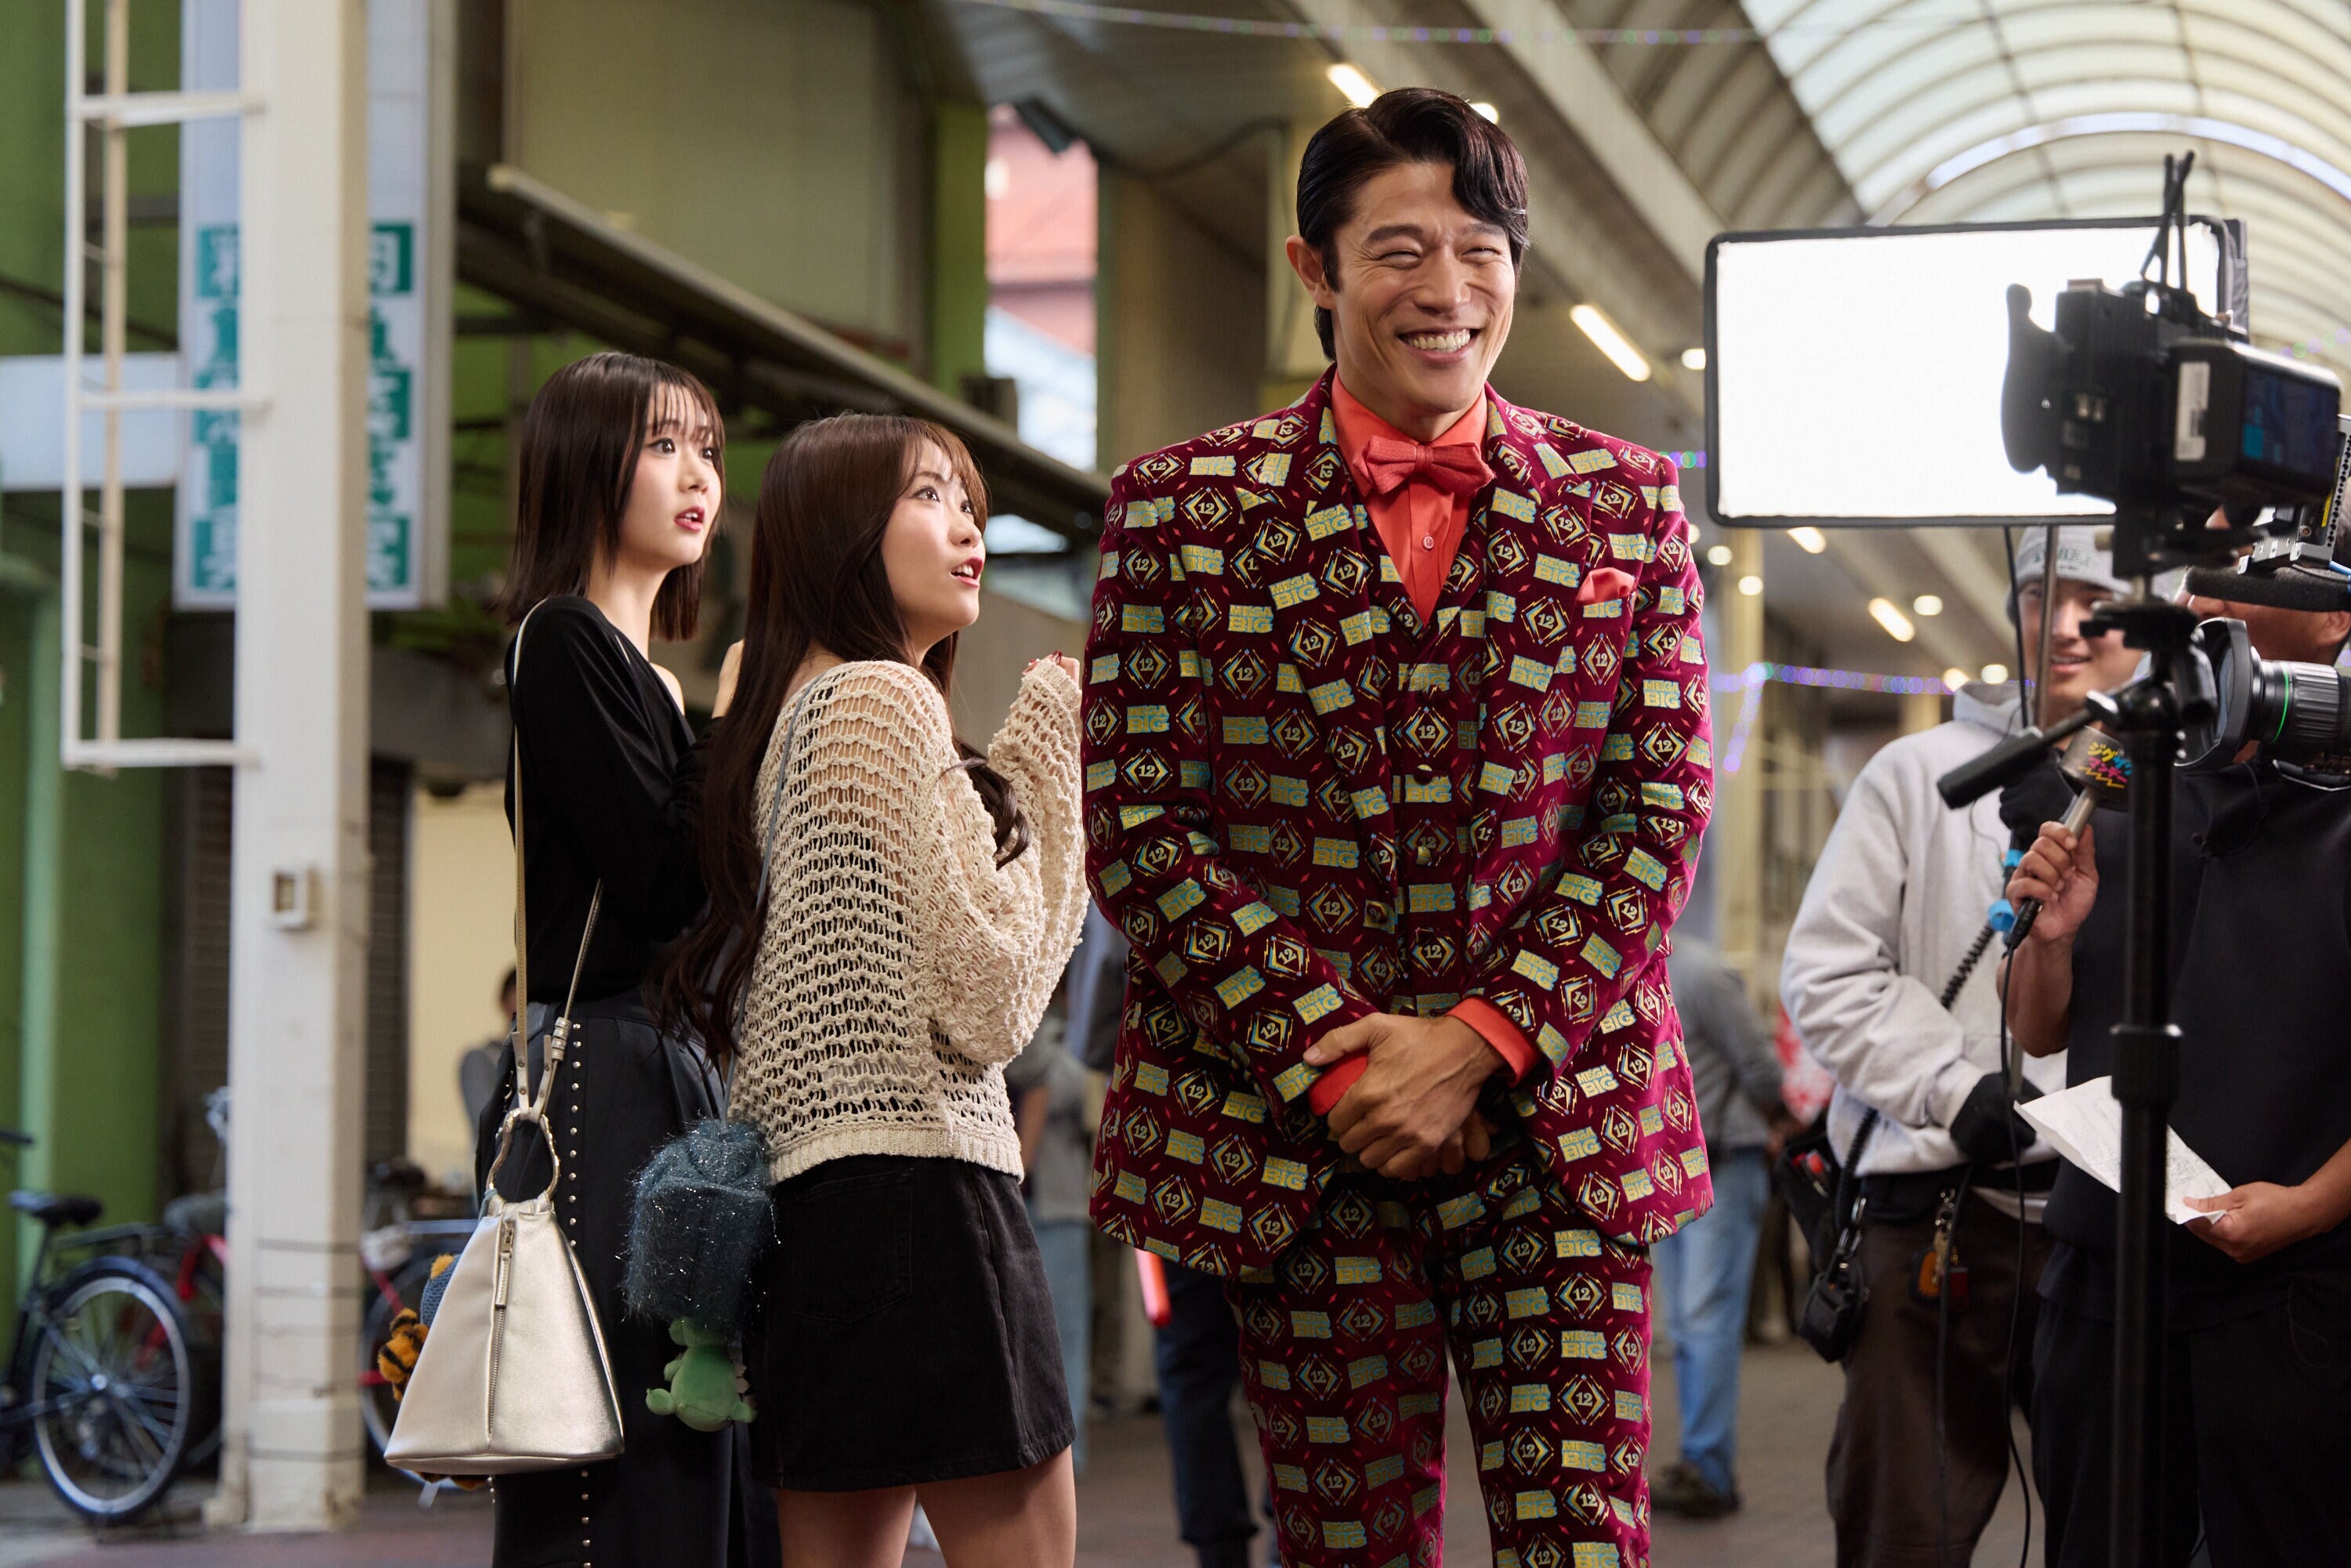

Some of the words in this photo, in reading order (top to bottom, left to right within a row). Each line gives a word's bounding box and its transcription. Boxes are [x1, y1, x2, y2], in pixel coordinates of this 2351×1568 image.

[1569, 449, 1612, 462] MEGA
[1571, 454, 1617, 473] BIG
[1633, 454, 1649, 463] 12
[1190, 463, 1234, 476] BIG
[1259, 454, 1283, 483] BIG
[1274, 454, 1291, 485] MEGA
[1494, 489, 1535, 509] MEGA
[1605, 494, 1621, 505] 12
[1199, 502, 1215, 514] 12
[1306, 505, 1346, 527] MEGA
[1492, 497, 1534, 522] BIG
[1308, 513, 1353, 540] BIG
[1559, 516, 1573, 531] 12
[1267, 532, 1284, 548] 12
[1610, 534, 1645, 543] MEGA
[1183, 546, 1223, 559] MEGA
[1497, 545, 1513, 559] 12
[1612, 543, 1646, 559] BIG
[1667, 541, 1679, 555] 12
[1136, 558, 1149, 570] 12
[1183, 556, 1223, 574] BIG
[1538, 554, 1578, 573] MEGA
[1337, 564, 1354, 580] 12
[1535, 562, 1578, 586] BIG
[1270, 574, 1313, 596] MEGA
[1273, 581, 1319, 609] BIG
[1123, 606, 1162, 617] MEGA
[1230, 607, 1271, 617] MEGA
[1122, 614, 1164, 632] BIG
[1229, 615, 1272, 632] BIG
[1538, 614, 1554, 628] 12
[1303, 636, 1320, 650] 12
[1662, 638, 1676, 649] 12
[1513, 656, 1552, 676] MEGA
[1596, 654, 1607, 665] 12
[1237, 668, 1253, 681] 12
[1509, 665, 1550, 691] BIG
[1309, 679, 1348, 699] MEGA
[1644, 680, 1679, 693] MEGA
[1313, 687, 1354, 714] BIG
[1645, 690, 1679, 708] BIG
[1128, 706, 1168, 717] MEGA
[1094, 716, 1106, 728] 12
[1128, 715, 1168, 733] BIG
[1510, 720, 1525, 734] 12
[1419, 726, 1436, 738] 12
[1338, 744, 1356, 758] 12
[1657, 741, 1672, 752] 12
[1139, 765, 1156, 777] 12
[1699, 796, 1712, 809] 12
[1502, 817, 1536, 832] MEGA
[1661, 819, 1677, 832] 12
[1502, 826, 1537, 848] BIG
[1315, 838, 1357, 853] MEGA
[1592, 842, 1608, 853] 12
[1149, 848, 1167, 863] 12
[1314, 848, 1357, 867] BIG
[1631, 848, 1667, 877] MEGA
[1624, 855, 1665, 890] BIG
[1509, 878, 1523, 892] 12
[1562, 874, 1602, 892] MEGA
[1157, 878, 1197, 909] MEGA
[1556, 881, 1600, 905] BIG
[1161, 885, 1205, 922] BIG
[1621, 904, 1638, 919] 12
[1232, 901, 1267, 923] MEGA
[1237, 907, 1277, 936] BIG
[1550, 919, 1567, 932] 12
[1198, 934, 1218, 950] 12
[1588, 933, 1622, 966] MEGA
[1278, 948, 1297, 964] 12
[1425, 945, 1442, 958] 12
[1518, 951, 1559, 976] MEGA
[1581, 941, 1618, 979] BIG
[1216, 966, 1255, 996] MEGA
[1512, 958, 1556, 990] BIG
[1221, 972, 1265, 1009] BIG
[1294, 983, 1334, 1011] MEGA
[1299, 990, 1342, 1024] BIG
[1573, 991, 1588, 1009] 12
[1645, 996, 1654, 1009] 12
[1507, 1005, 1521, 1021] 12
[1261, 1023, 1278, 1039] 12
[1138, 1062, 1168, 1080] MEGA
[1630, 1059, 1646, 1073] 12
[1134, 1070, 1168, 1095] BIG
[1576, 1066, 1611, 1083] MEGA
[1188, 1085, 1204, 1098] 12
[1581, 1073, 1618, 1097] BIG
[1228, 1092, 1266, 1108] MEGA
[1223, 1099, 1265, 1122] BIG
[1672, 1103, 1682, 1116] 12
[1559, 1128, 1595, 1146] MEGA
[1614, 1123, 1628, 1137] 12
[1169, 1130, 1204, 1148] MEGA
[1165, 1139, 1203, 1163] BIG
[1562, 1135, 1601, 1162] BIG
[1680, 1147, 1704, 1164] MEGA
[1266, 1157, 1307, 1175] MEGA
[1661, 1166, 1672, 1179] 12
[1684, 1156, 1707, 1179] BIG
[1118, 1170, 1145, 1189] MEGA
[1262, 1166, 1306, 1190] BIG
[1621, 1168, 1649, 1186] MEGA
[1114, 1179, 1145, 1204] BIG
[1624, 1176, 1654, 1201] BIG
[1165, 1193, 1180, 1208] 12
[1591, 1192, 1607, 1204] 12
[1203, 1197, 1241, 1217] MEGA
[1200, 1207, 1241, 1233] BIG
[1556, 1231, 1599, 1242] MEGA
[1654, 1227, 1667, 1240] 12
[1556, 1240, 1601, 1257] BIG
[1297, 1265, 1312, 1276] 12
[1335, 1258, 1379, 1267] MEGA
[1336, 1266, 1381, 1284] BIG
[1507, 1287, 1545, 1302] MEGA
[1574, 1288, 1590, 1301] 12
[1613, 1284, 1641, 1297] MEGA
[1508, 1296, 1549, 1318] BIG
[1614, 1292, 1643, 1313] BIG
[1257, 1316, 1271, 1327] 12
[1291, 1312, 1328, 1323] MEGA
[1354, 1315, 1371, 1327] 12
[1293, 1321, 1331, 1338] BIG
[1563, 1332, 1604, 1342] MEGA
[1473, 1339, 1501, 1354] MEGA
[1563, 1342, 1606, 1359] BIG
[1625, 1343, 1637, 1356] 12
[1412, 1354, 1426, 1367] 12
[1473, 1348, 1502, 1368] BIG
[1311, 1371, 1326, 1383] 12
[1576, 1392, 1592, 1406] 12
[1616, 1391, 1641, 1406] MEGA
[1616, 1401, 1641, 1422] BIG
[1273, 1421, 1287, 1432] 12
[1307, 1418, 1346, 1427] MEGA
[1371, 1414, 1386, 1428] 12
[1309, 1426, 1349, 1442] BIG
[1563, 1441, 1604, 1454] MEGA
[1563, 1450, 1604, 1471] BIG
[1626, 1454, 1639, 1465] 12
[1327, 1476, 1342, 1488] 12
[1580, 1494, 1598, 1506] 12
[1323, 1522, 1362, 1532] MEGA
[1324, 1530, 1366, 1548] BIG
